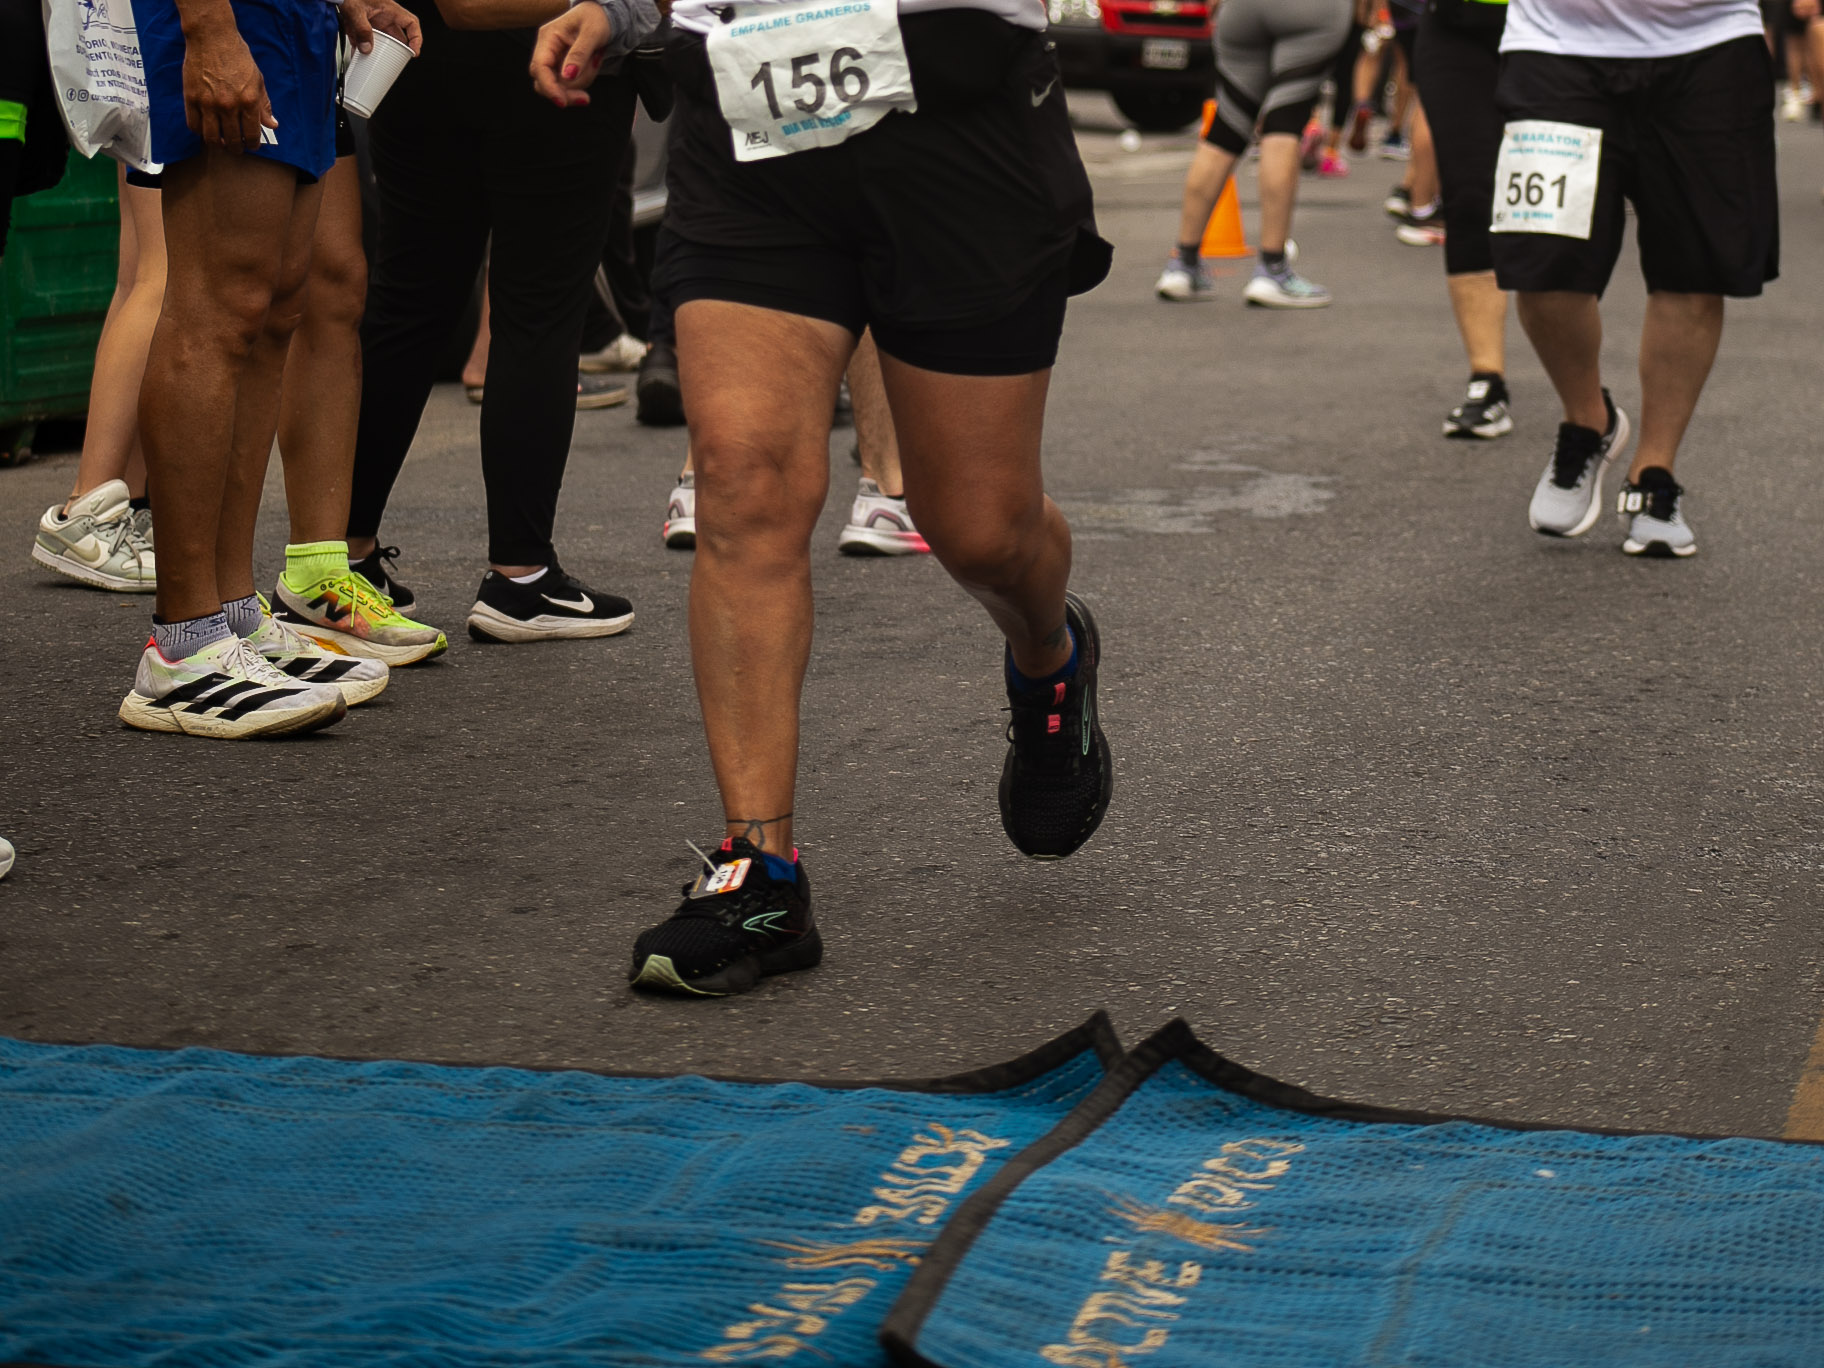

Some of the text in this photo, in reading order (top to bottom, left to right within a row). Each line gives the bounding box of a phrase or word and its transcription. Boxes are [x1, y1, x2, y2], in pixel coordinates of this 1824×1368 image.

[730, 2, 872, 38] EMPALME GRANEROS
[751, 46, 870, 120] 156
[1506, 172, 1567, 209] 561
